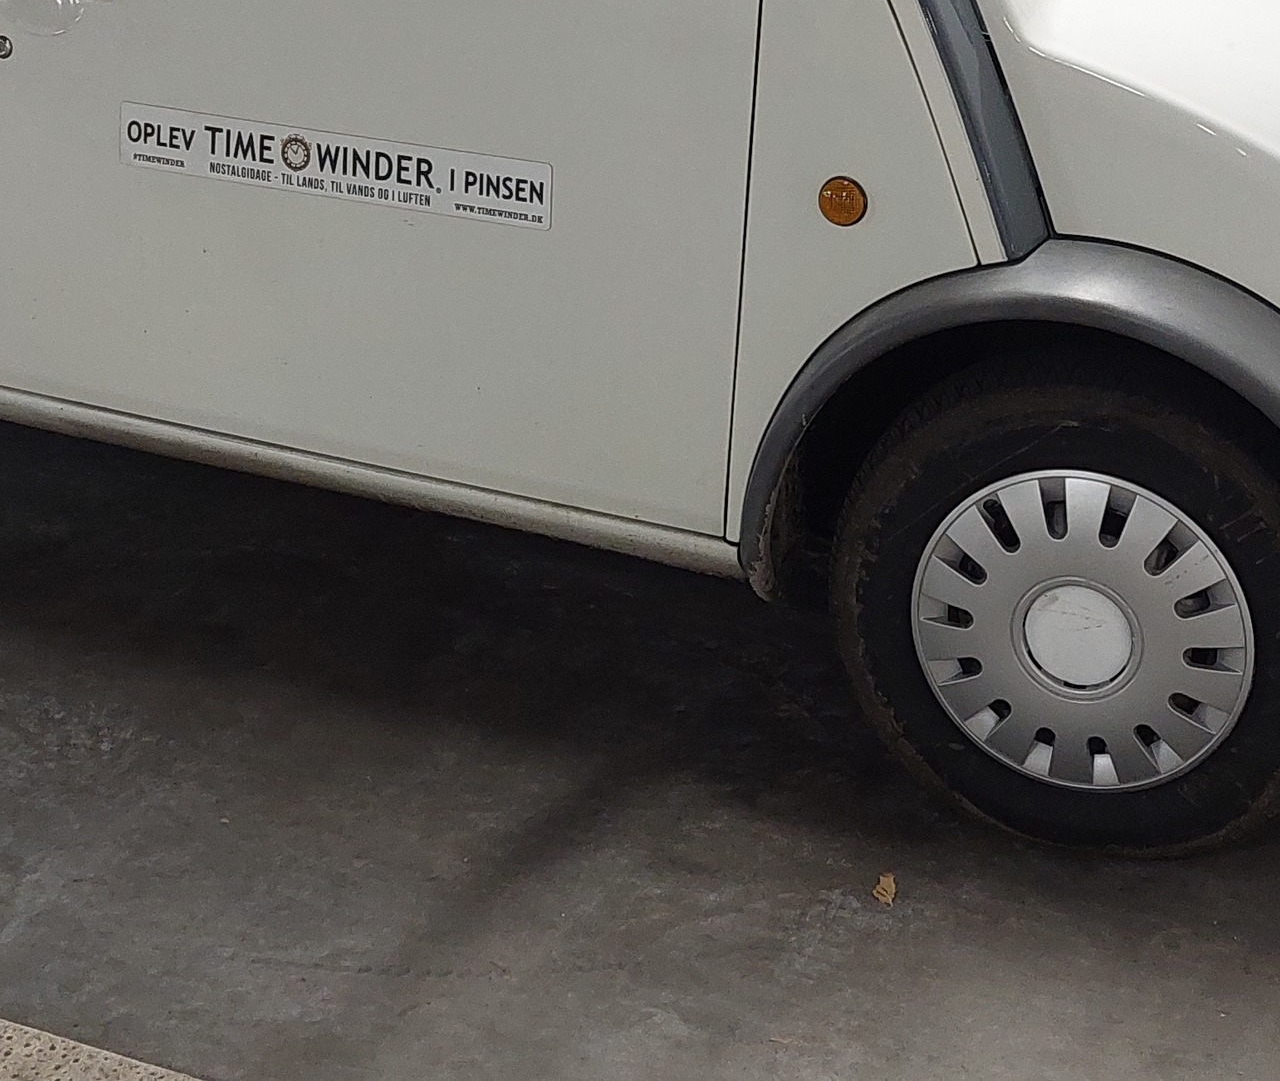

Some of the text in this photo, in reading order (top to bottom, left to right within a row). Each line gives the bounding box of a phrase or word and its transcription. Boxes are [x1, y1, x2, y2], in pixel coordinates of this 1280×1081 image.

[127, 120, 196, 151] OPLEV
[204, 125, 275, 164] TIME
[450, 168, 455, 192] I
[464, 170, 544, 206] PINSEN
[133, 152, 185, 168] #TIMEWINDER
[209, 161, 272, 183] NOSTALGIDAGE
[281, 173, 295, 186] TIL
[297, 175, 327, 192] LANDS,
[331, 180, 344, 194] TIL
[347, 183, 375, 198] VANDS
[378, 188, 389, 201] OG
[398, 192, 431, 207] LUFTEN
[454, 203, 544, 224] WWW.TIMEWINDER.DK
